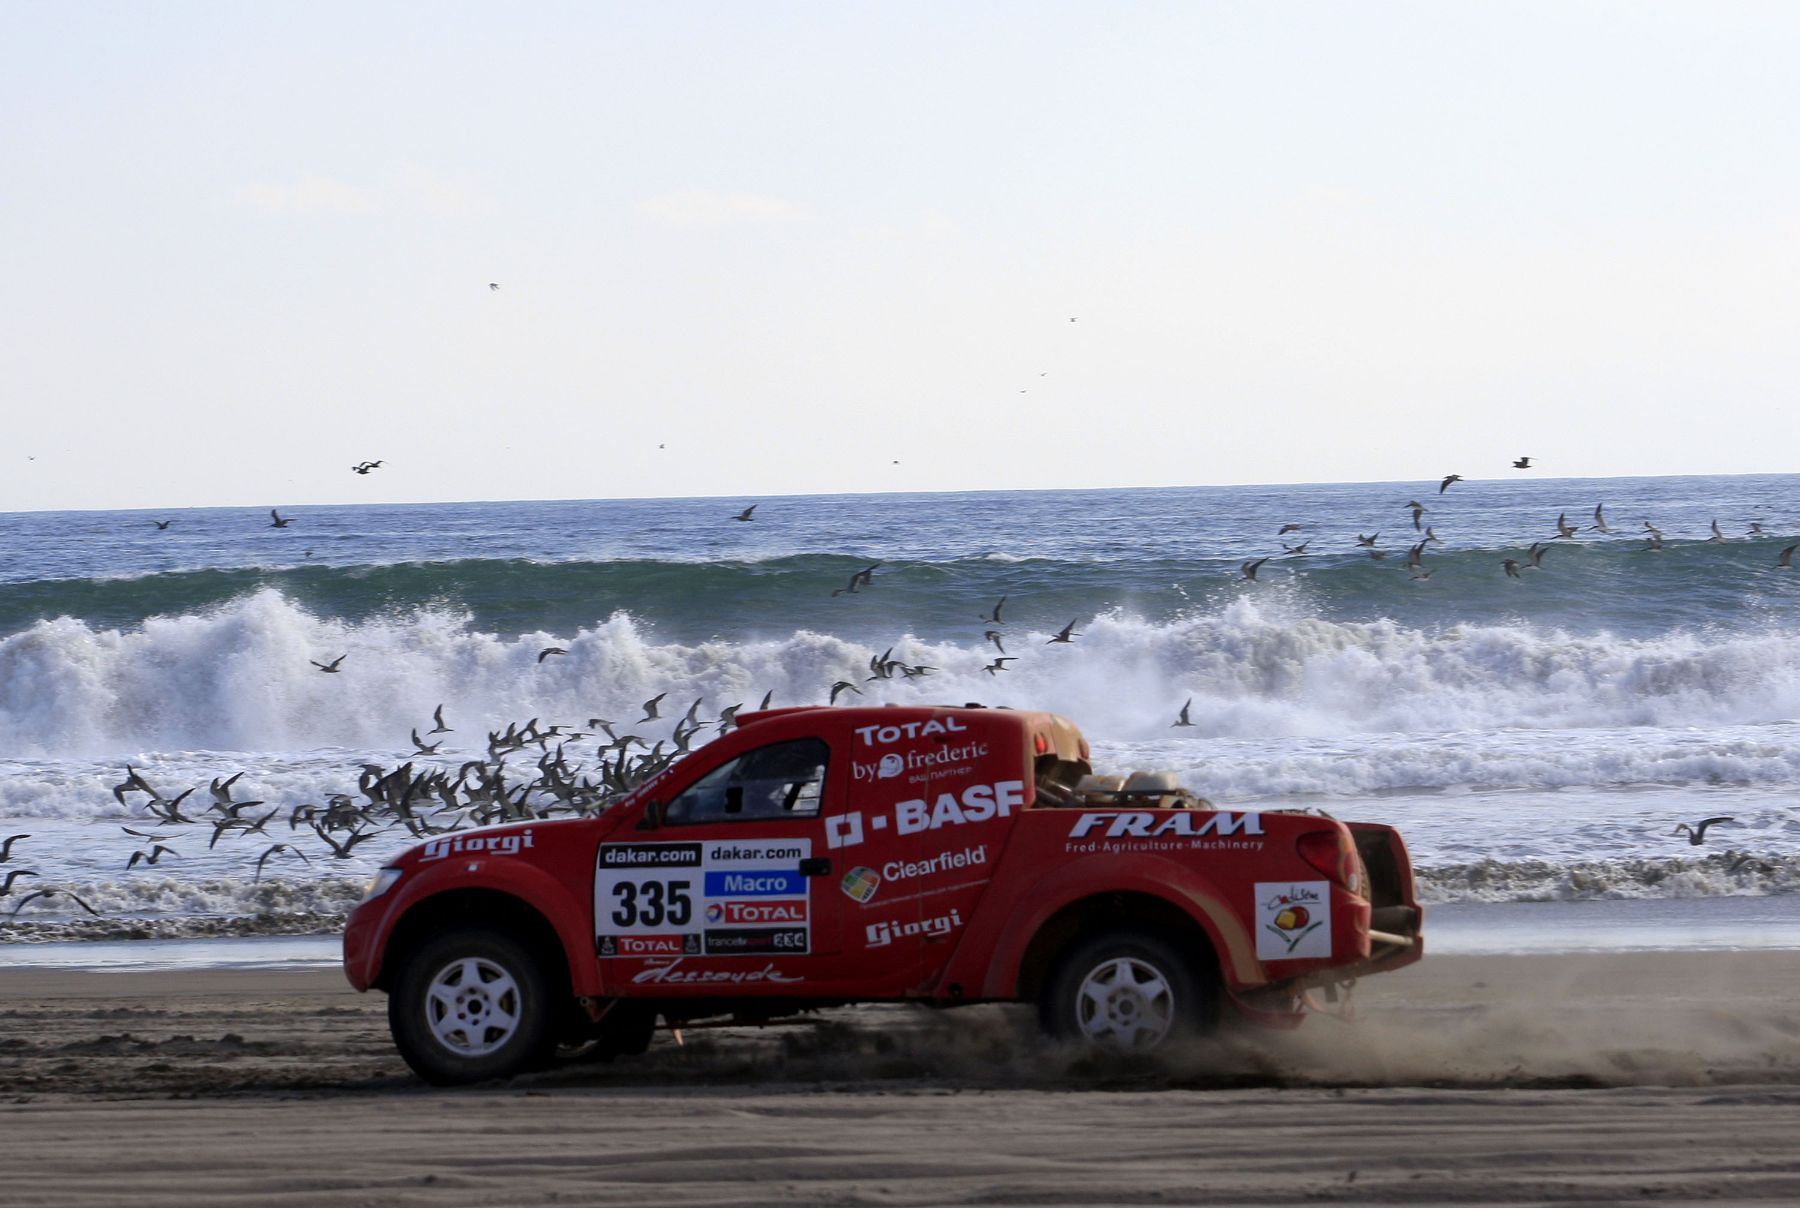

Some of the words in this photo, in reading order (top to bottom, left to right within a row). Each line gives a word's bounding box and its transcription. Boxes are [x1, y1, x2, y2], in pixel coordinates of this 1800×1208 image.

[855, 717, 967, 746] TOTAL
[852, 761, 877, 783] by
[908, 741, 988, 769] frederic
[895, 780, 1024, 836] BASF
[1068, 812, 1265, 838] FRAM
[419, 829, 535, 862] Giorgi
[605, 848, 696, 863] dakar.com
[711, 846, 801, 861] dakar.com
[883, 845, 986, 881] Clearfield
[724, 874, 787, 892] Macro
[612, 880, 692, 927] 335
[731, 904, 804, 920] TOTAL
[865, 908, 964, 948] Giorgi
[621, 937, 680, 951] TOTAL
